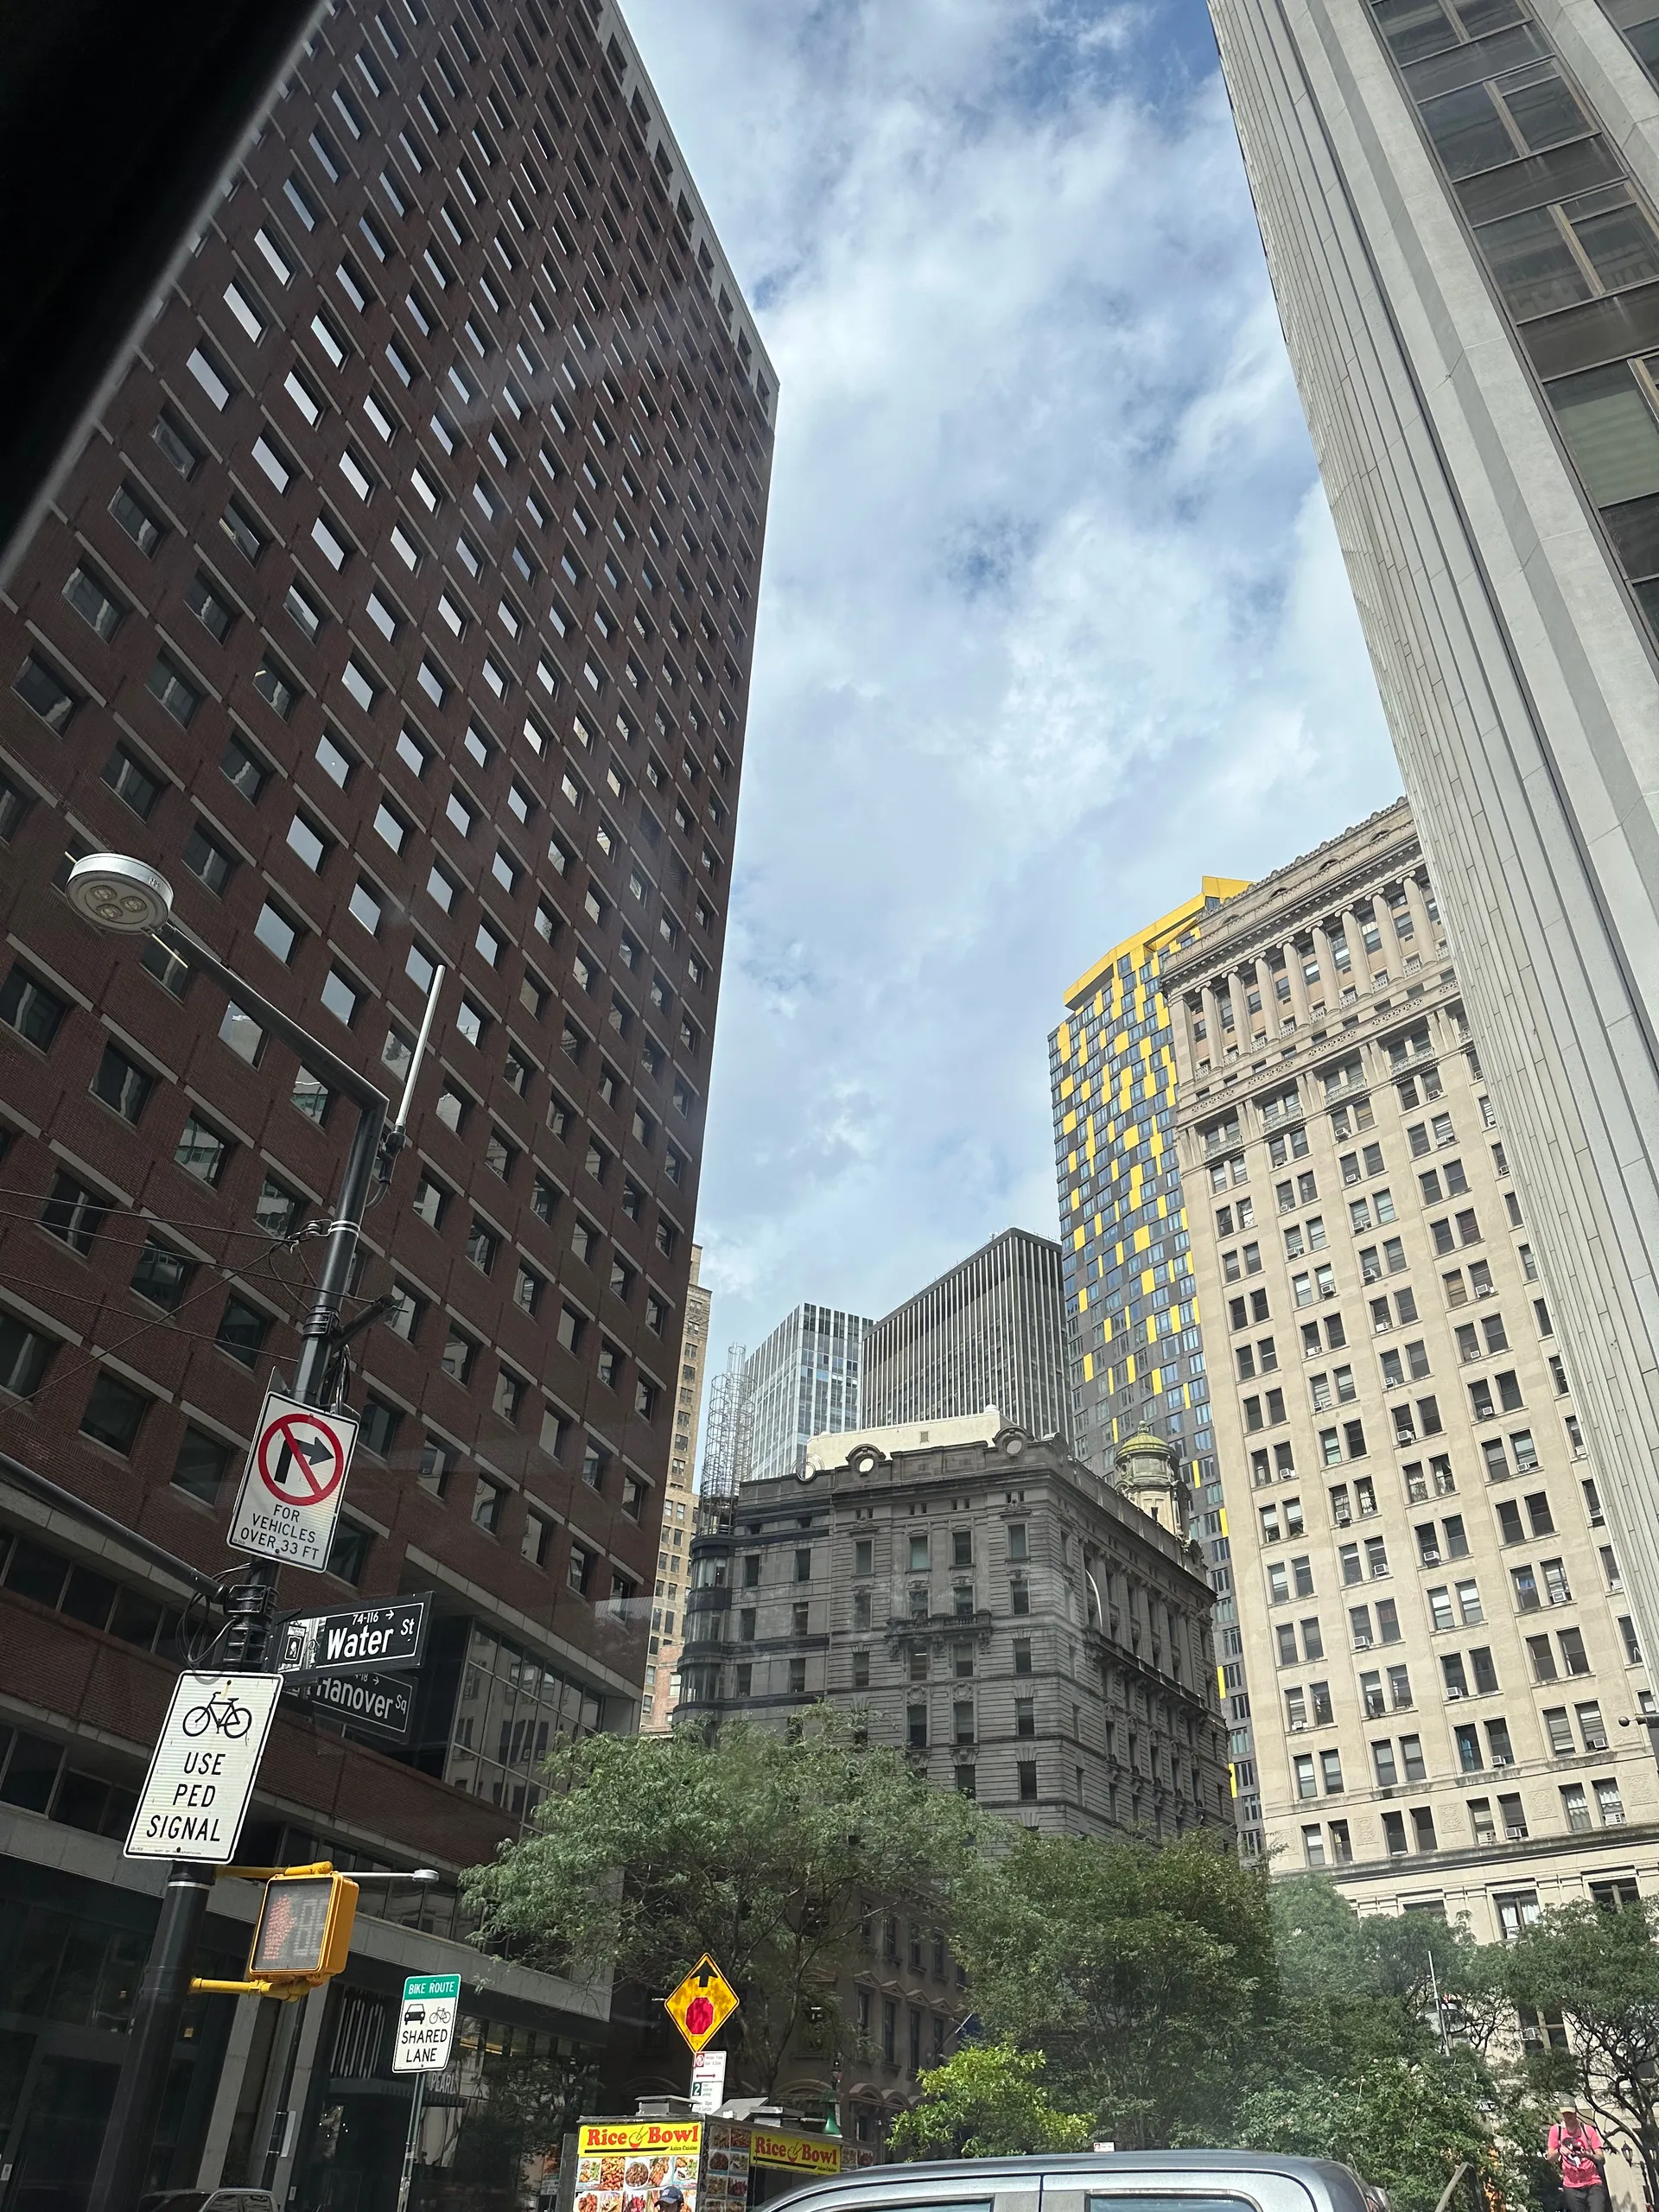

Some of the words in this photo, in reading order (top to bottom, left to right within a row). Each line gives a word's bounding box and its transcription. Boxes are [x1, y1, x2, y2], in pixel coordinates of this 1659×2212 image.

[273, 1503, 301, 1522] FOR
[252, 1513, 316, 1543] VEHICLES
[240, 1527, 276, 1549] OVER
[280, 1539, 298, 1554] 33
[302, 1545, 320, 1560] FT
[352, 1611, 379, 1625] 74-116
[327, 1624, 394, 1660] Water
[400, 1618, 415, 1636] St
[395, 1694, 408, 1715] Sq
[183, 1751, 226, 1776] USE
[172, 1783, 216, 1808] PED
[146, 1815, 220, 1842] SIGNAL
[408, 1983, 427, 1995] BIKE
[429, 1981, 455, 1993] ROUTE
[401, 2029, 448, 2044] SHARED
[405, 2048, 438, 2063] LANE
[693, 2082, 701, 2096] 2
[587, 2128, 627, 2145] Rice
[647, 2125, 699, 2144] Bowl
[754, 2135, 787, 2158] Rice
[801, 2143, 838, 2165] Bowl
